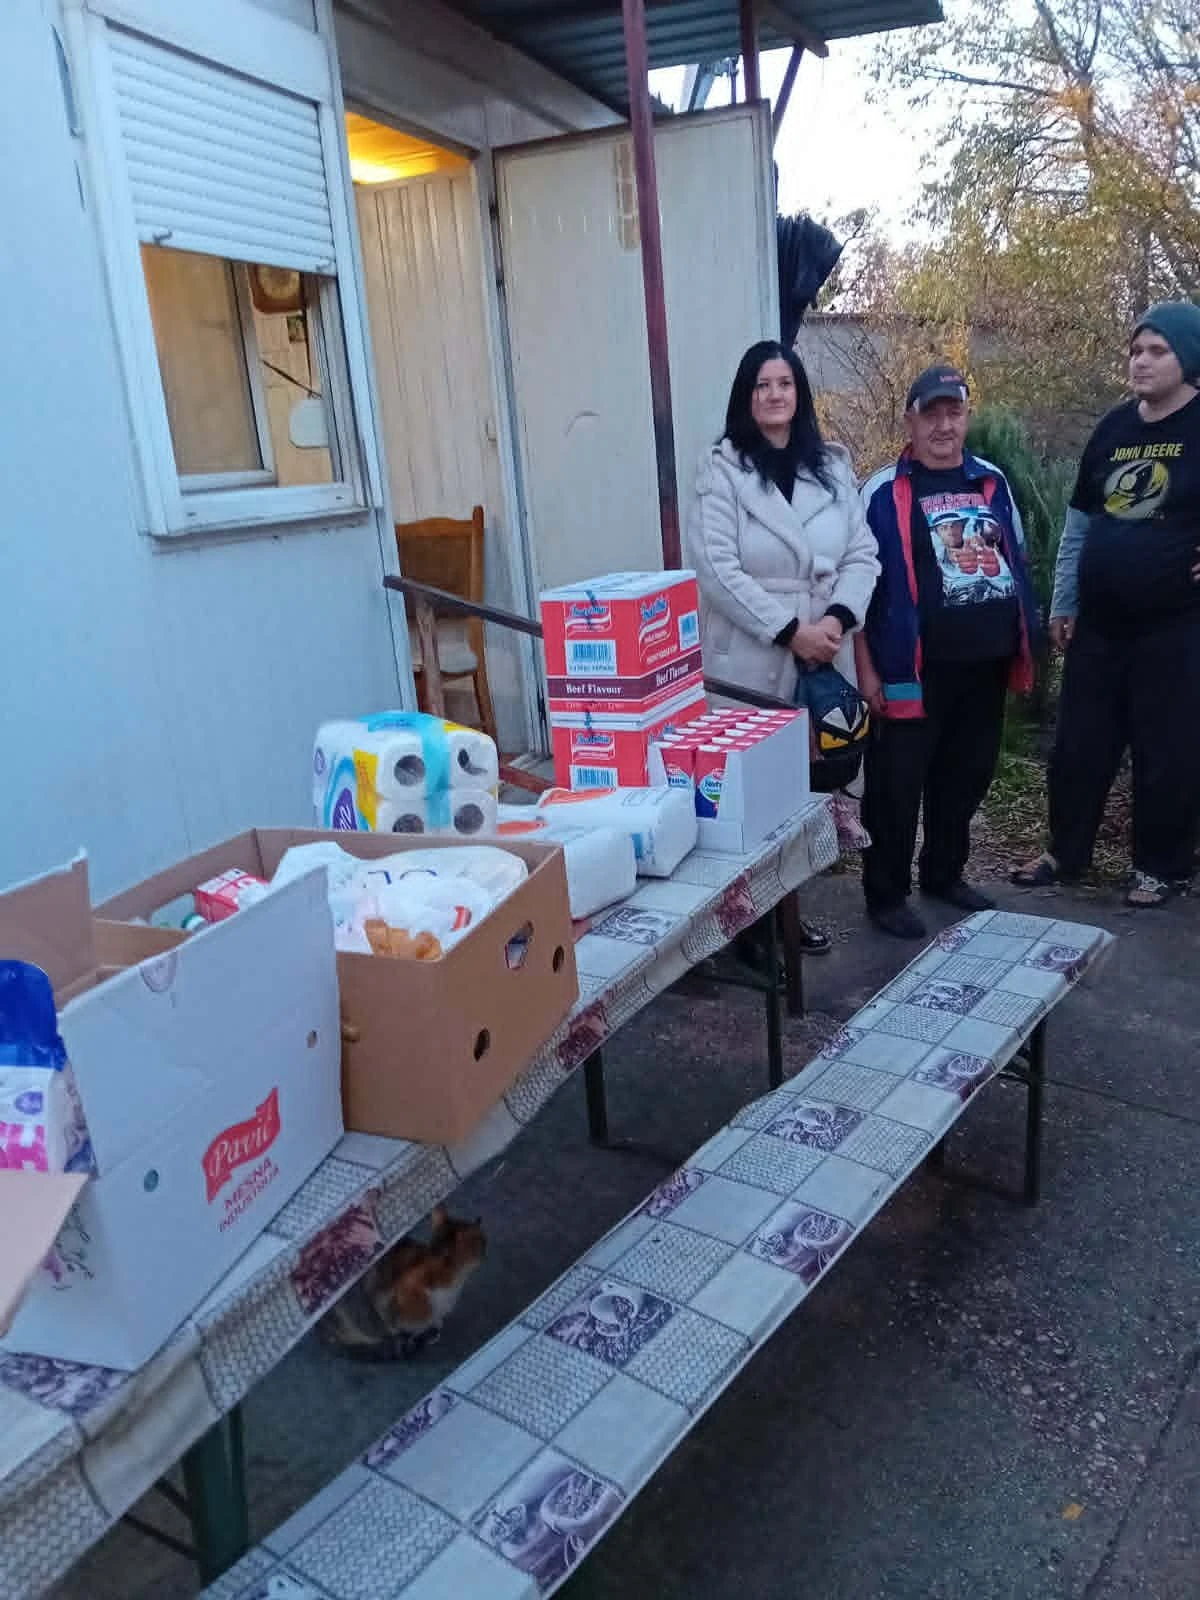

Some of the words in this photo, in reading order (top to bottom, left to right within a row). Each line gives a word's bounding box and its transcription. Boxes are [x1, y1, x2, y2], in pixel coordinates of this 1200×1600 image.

[1110, 446, 1141, 461] JOHN
[1143, 443, 1184, 457] DEERE
[566, 683, 585, 694] Beef
[587, 683, 621, 694] Flavour
